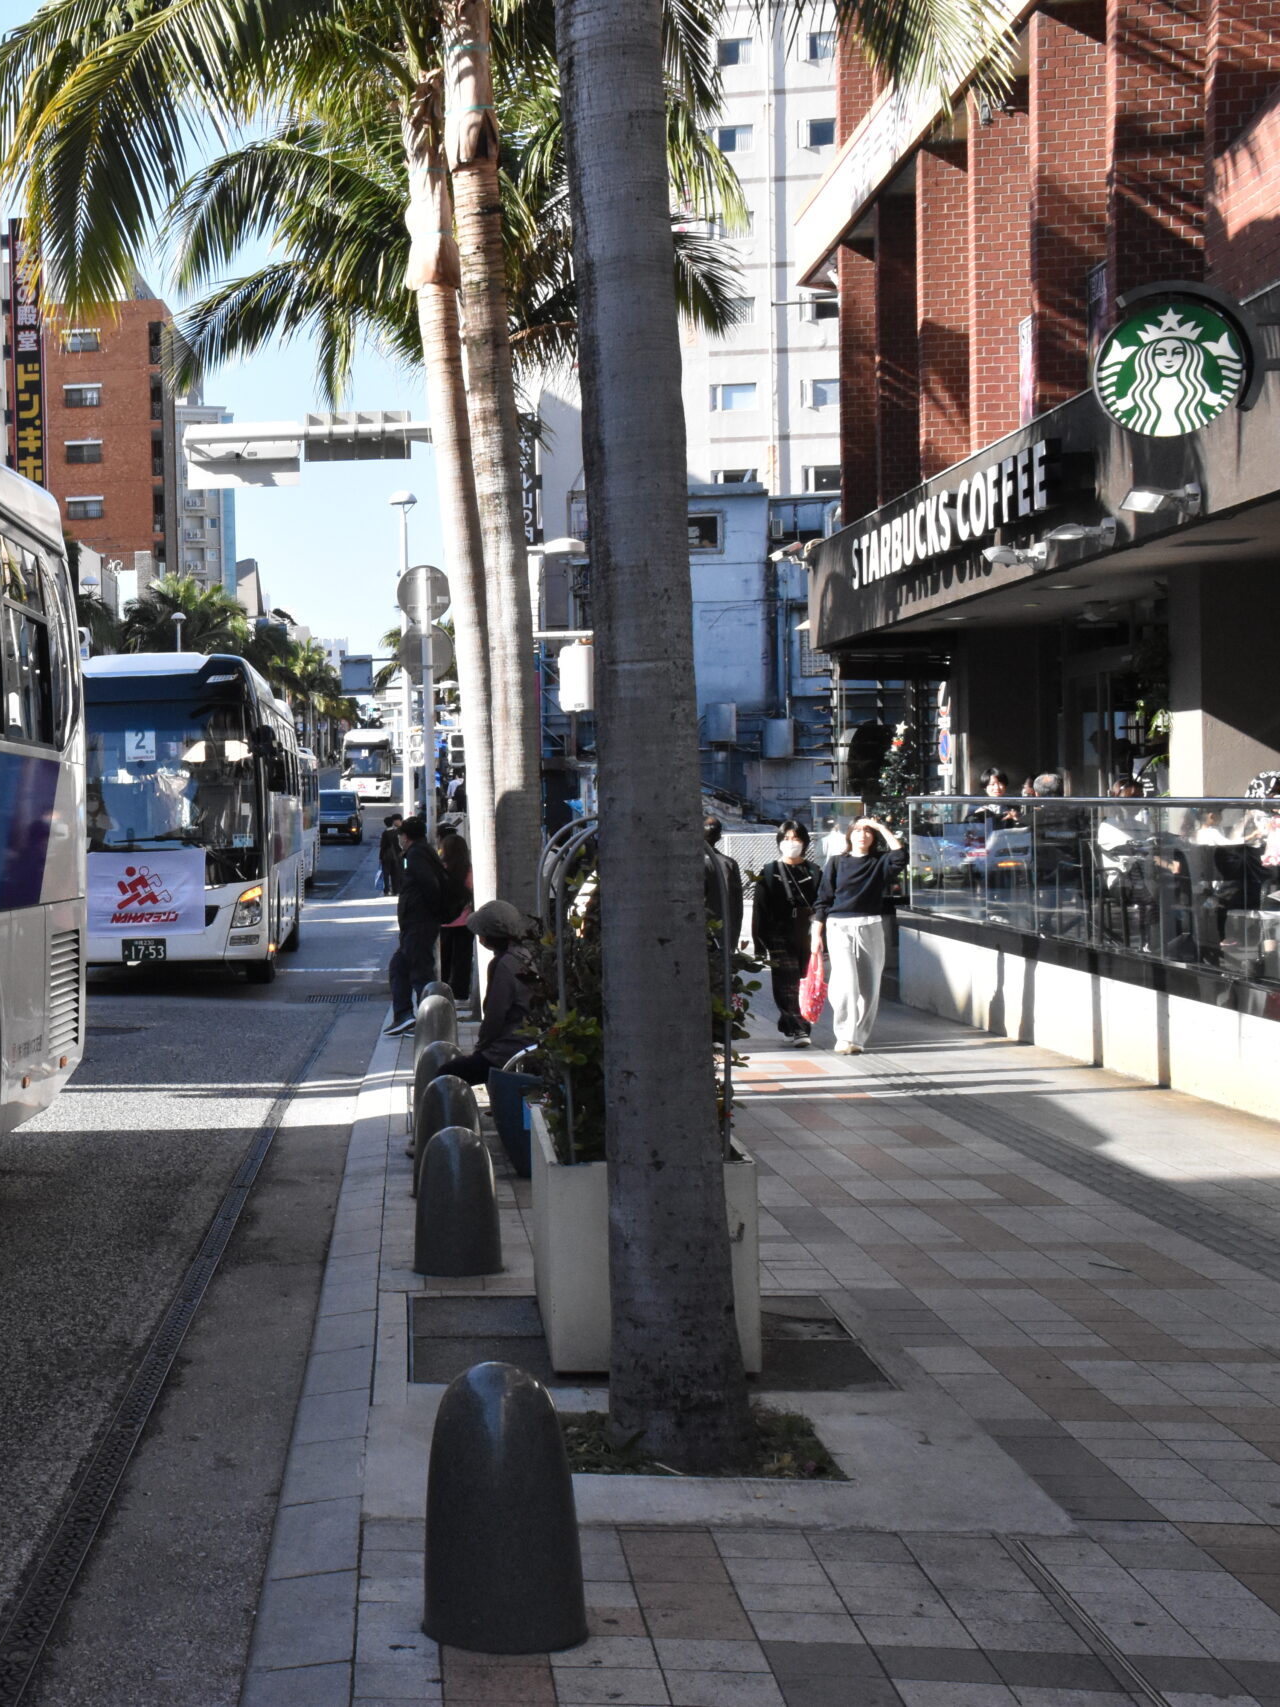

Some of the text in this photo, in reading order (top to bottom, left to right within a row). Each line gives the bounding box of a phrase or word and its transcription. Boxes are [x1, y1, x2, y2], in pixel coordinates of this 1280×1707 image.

[852, 440, 1047, 590] STARBUCKS COFFEE
[134, 730, 146, 750] 2
